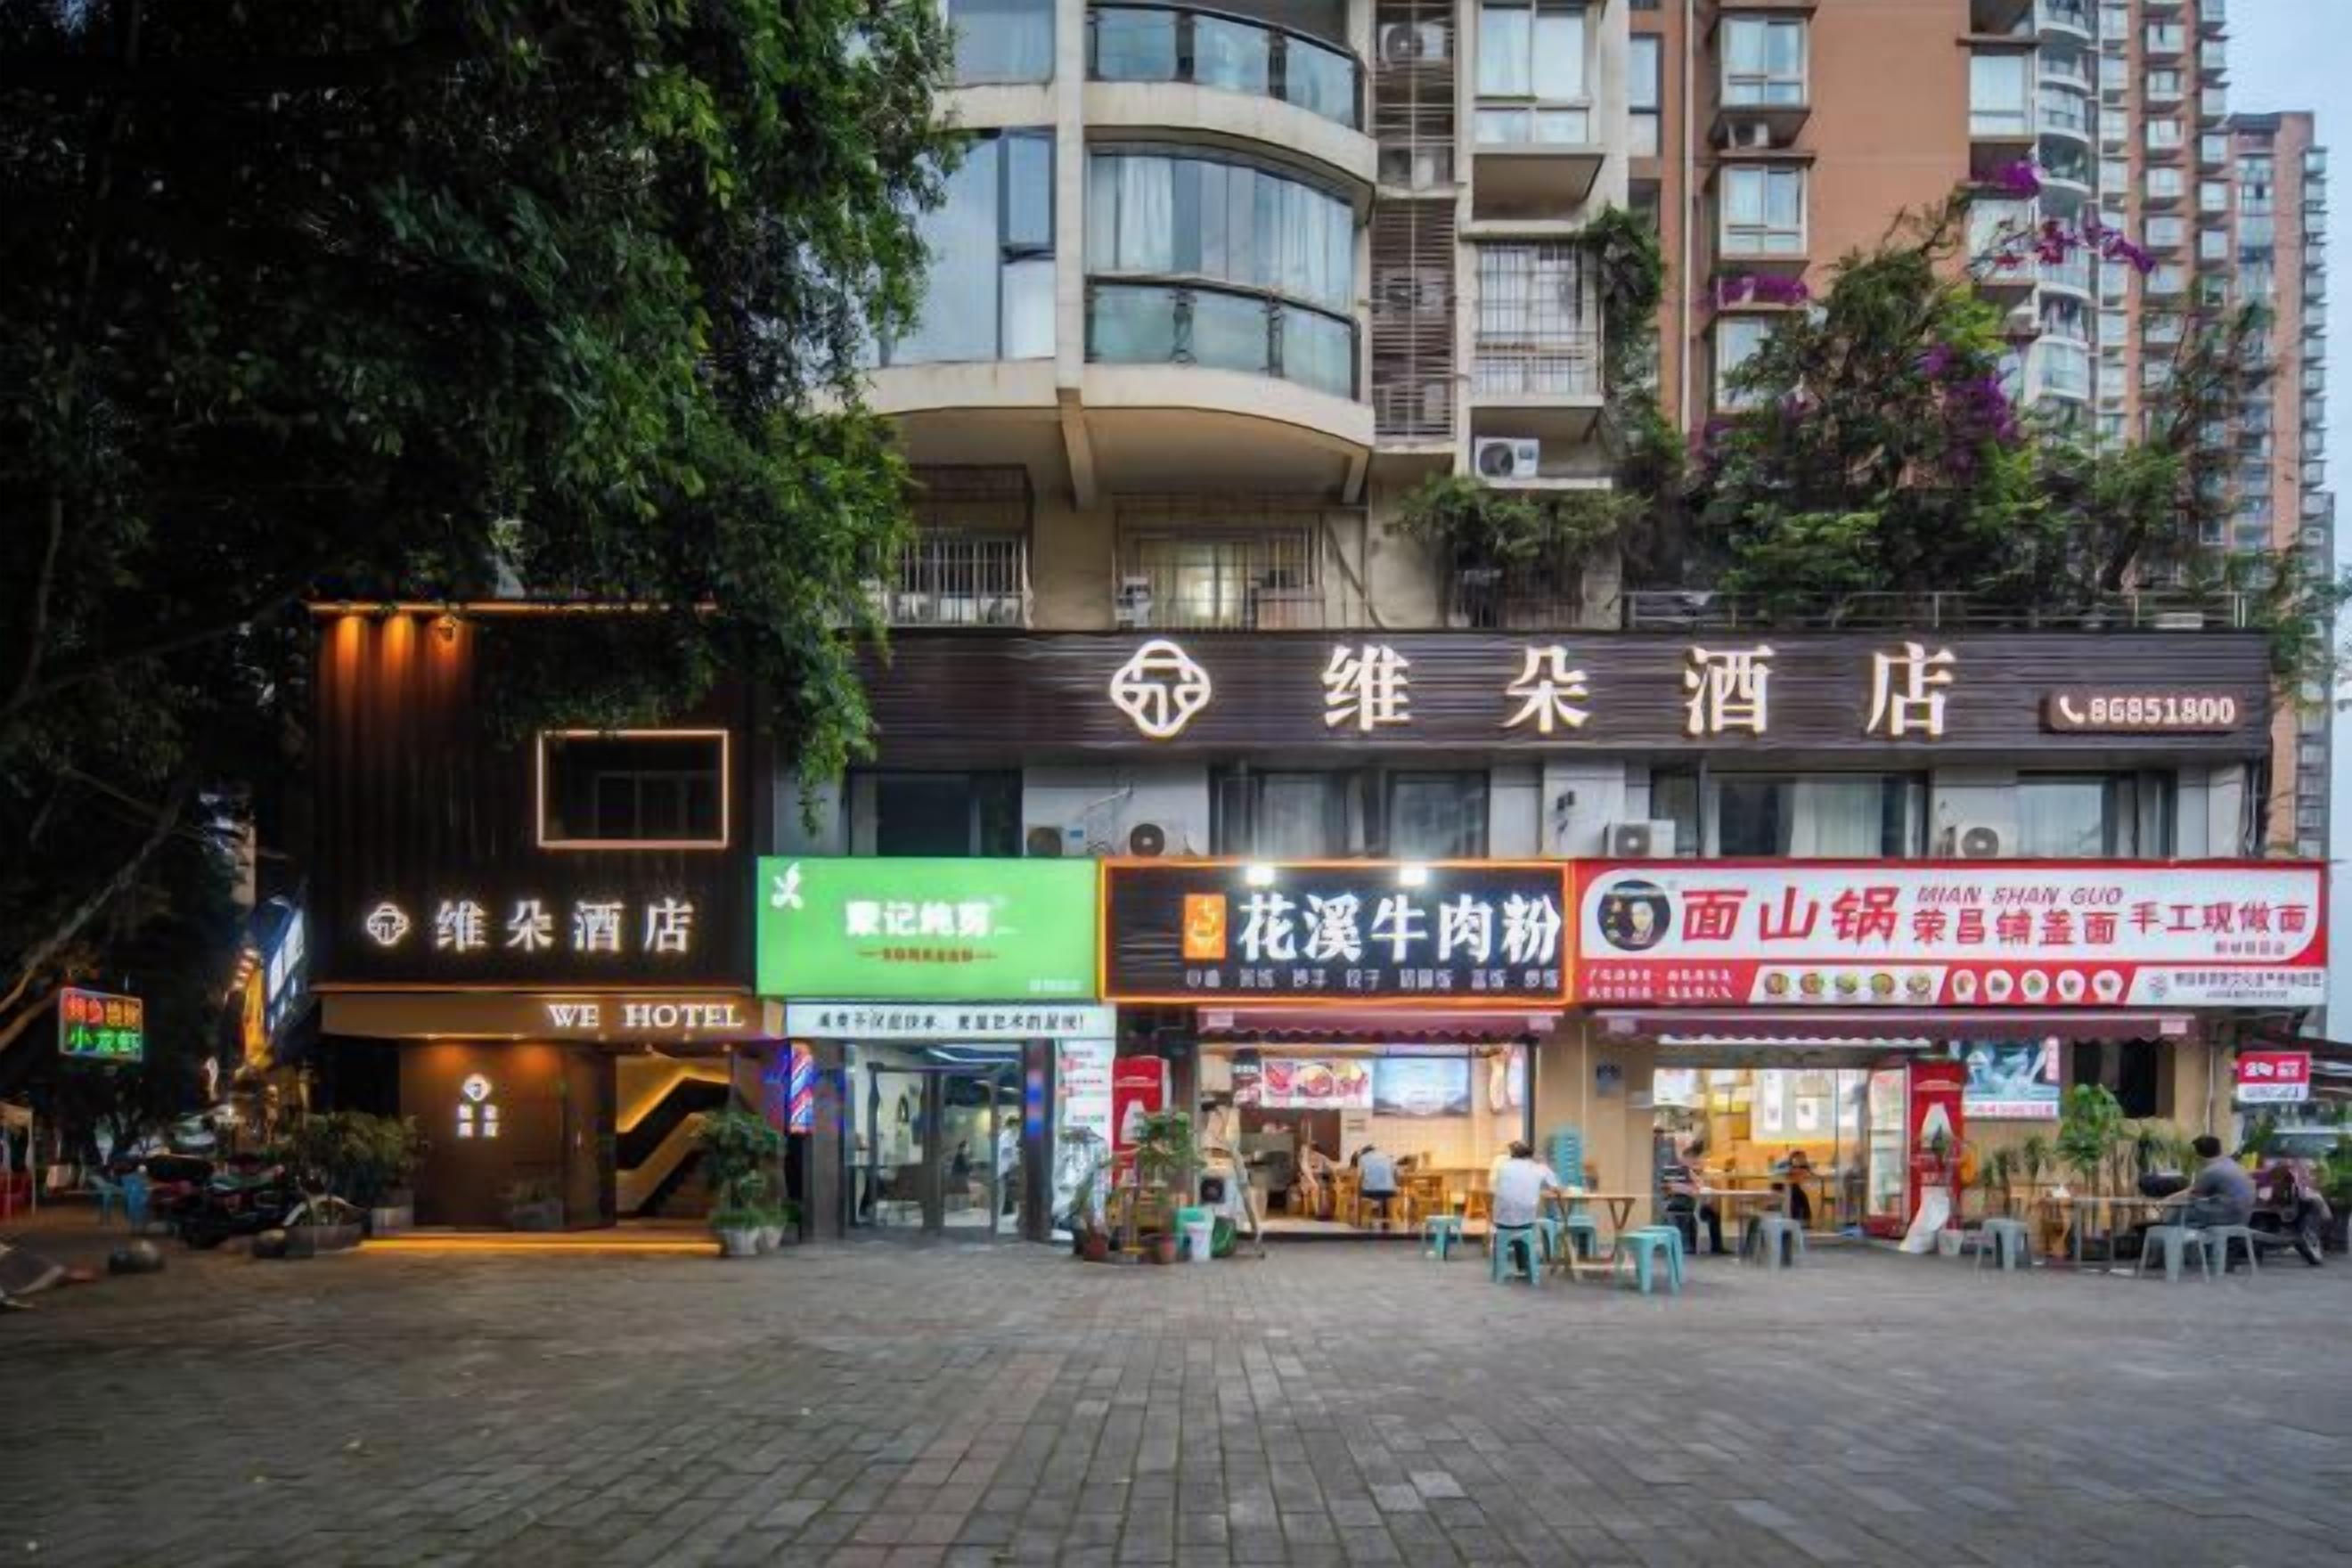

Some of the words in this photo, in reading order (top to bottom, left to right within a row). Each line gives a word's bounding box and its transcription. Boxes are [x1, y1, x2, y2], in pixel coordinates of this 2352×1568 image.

[1321, 641, 1957, 738] 维朵酒店
[2089, 697, 2236, 724] 86851800
[1679, 886, 1900, 946] 面山锅
[1918, 887, 1981, 904] MIAN
[1992, 887, 2061, 904] SHAN
[2070, 887, 2125, 905] GUO
[2128, 900, 2310, 935] 手工现做面
[436, 898, 695, 954] 维朵酒店
[1237, 892, 1562, 963] 花溪牛肉粉
[547, 1003, 600, 1028] WE
[625, 1003, 745, 1028] HOTEL
